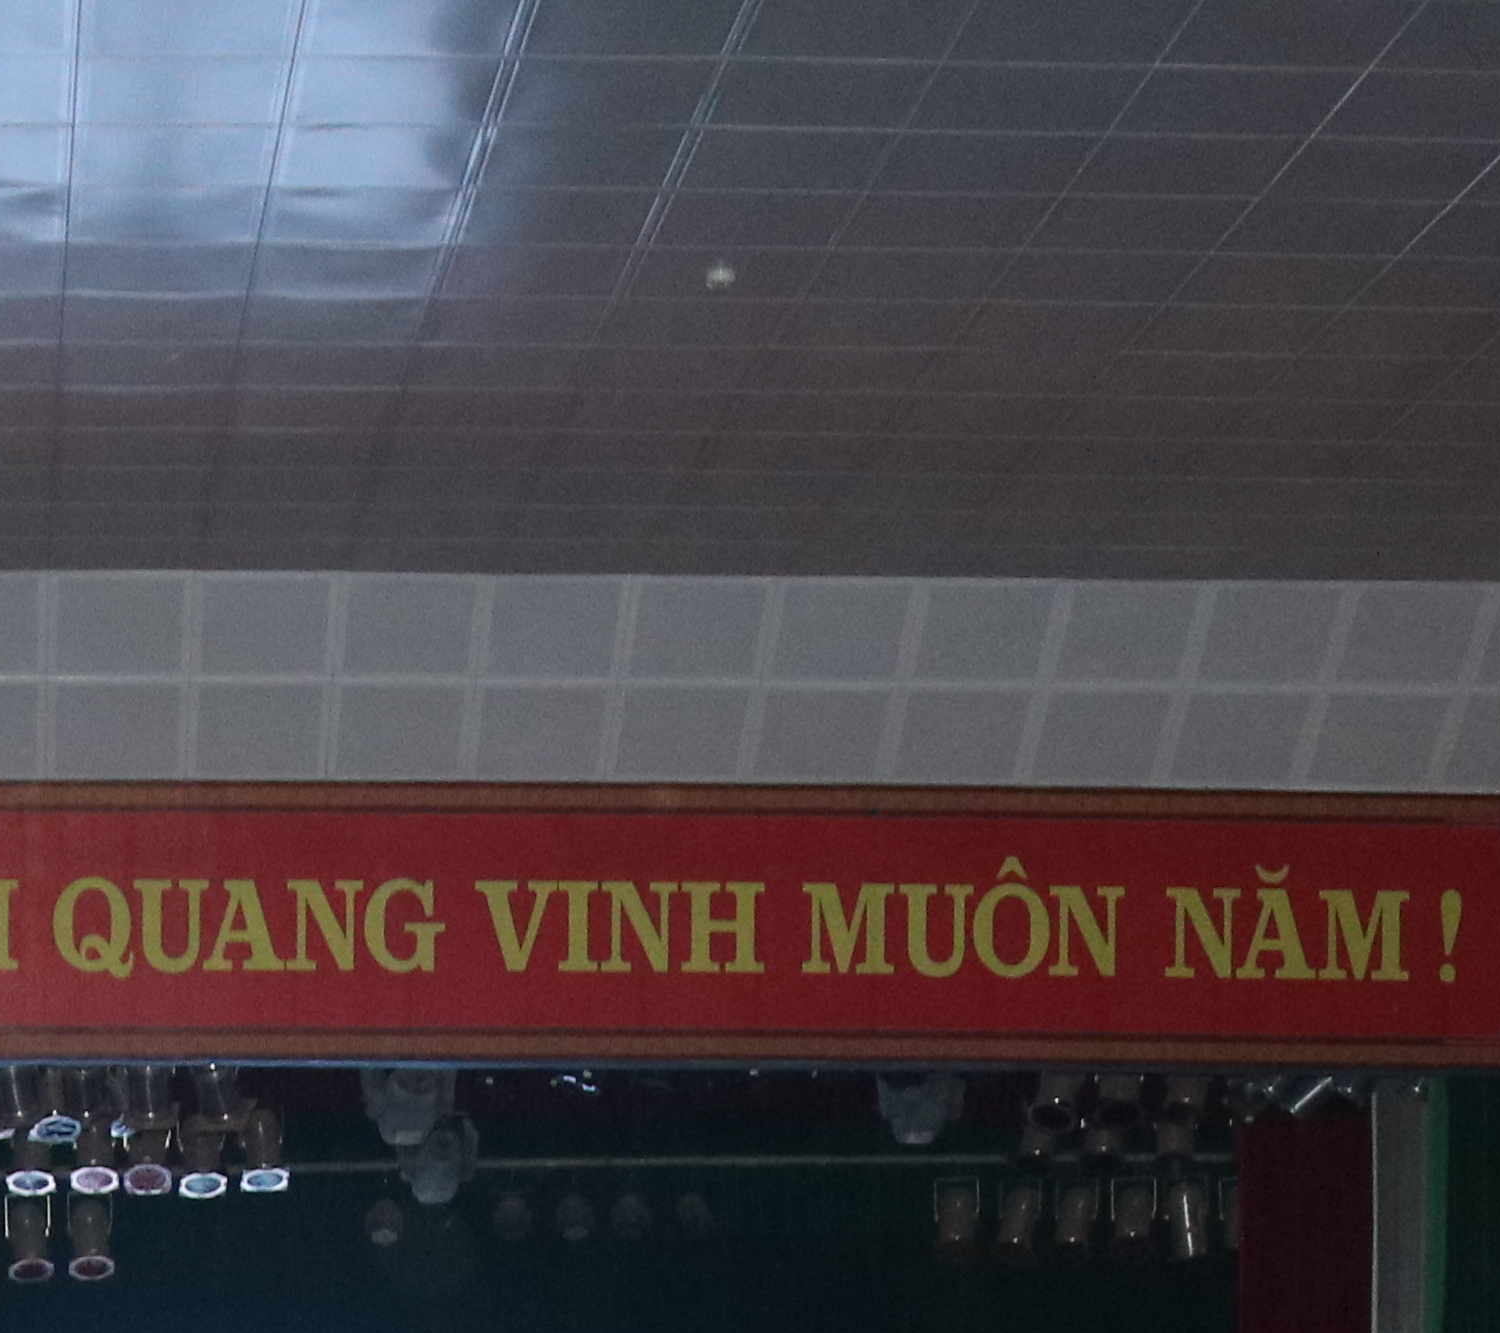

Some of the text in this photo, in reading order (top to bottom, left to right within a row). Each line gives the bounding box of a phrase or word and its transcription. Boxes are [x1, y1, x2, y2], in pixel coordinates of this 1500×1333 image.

[51, 874, 446, 979] QUANG
[474, 879, 765, 974] VINH
[801, 855, 1126, 978] MUÔN
